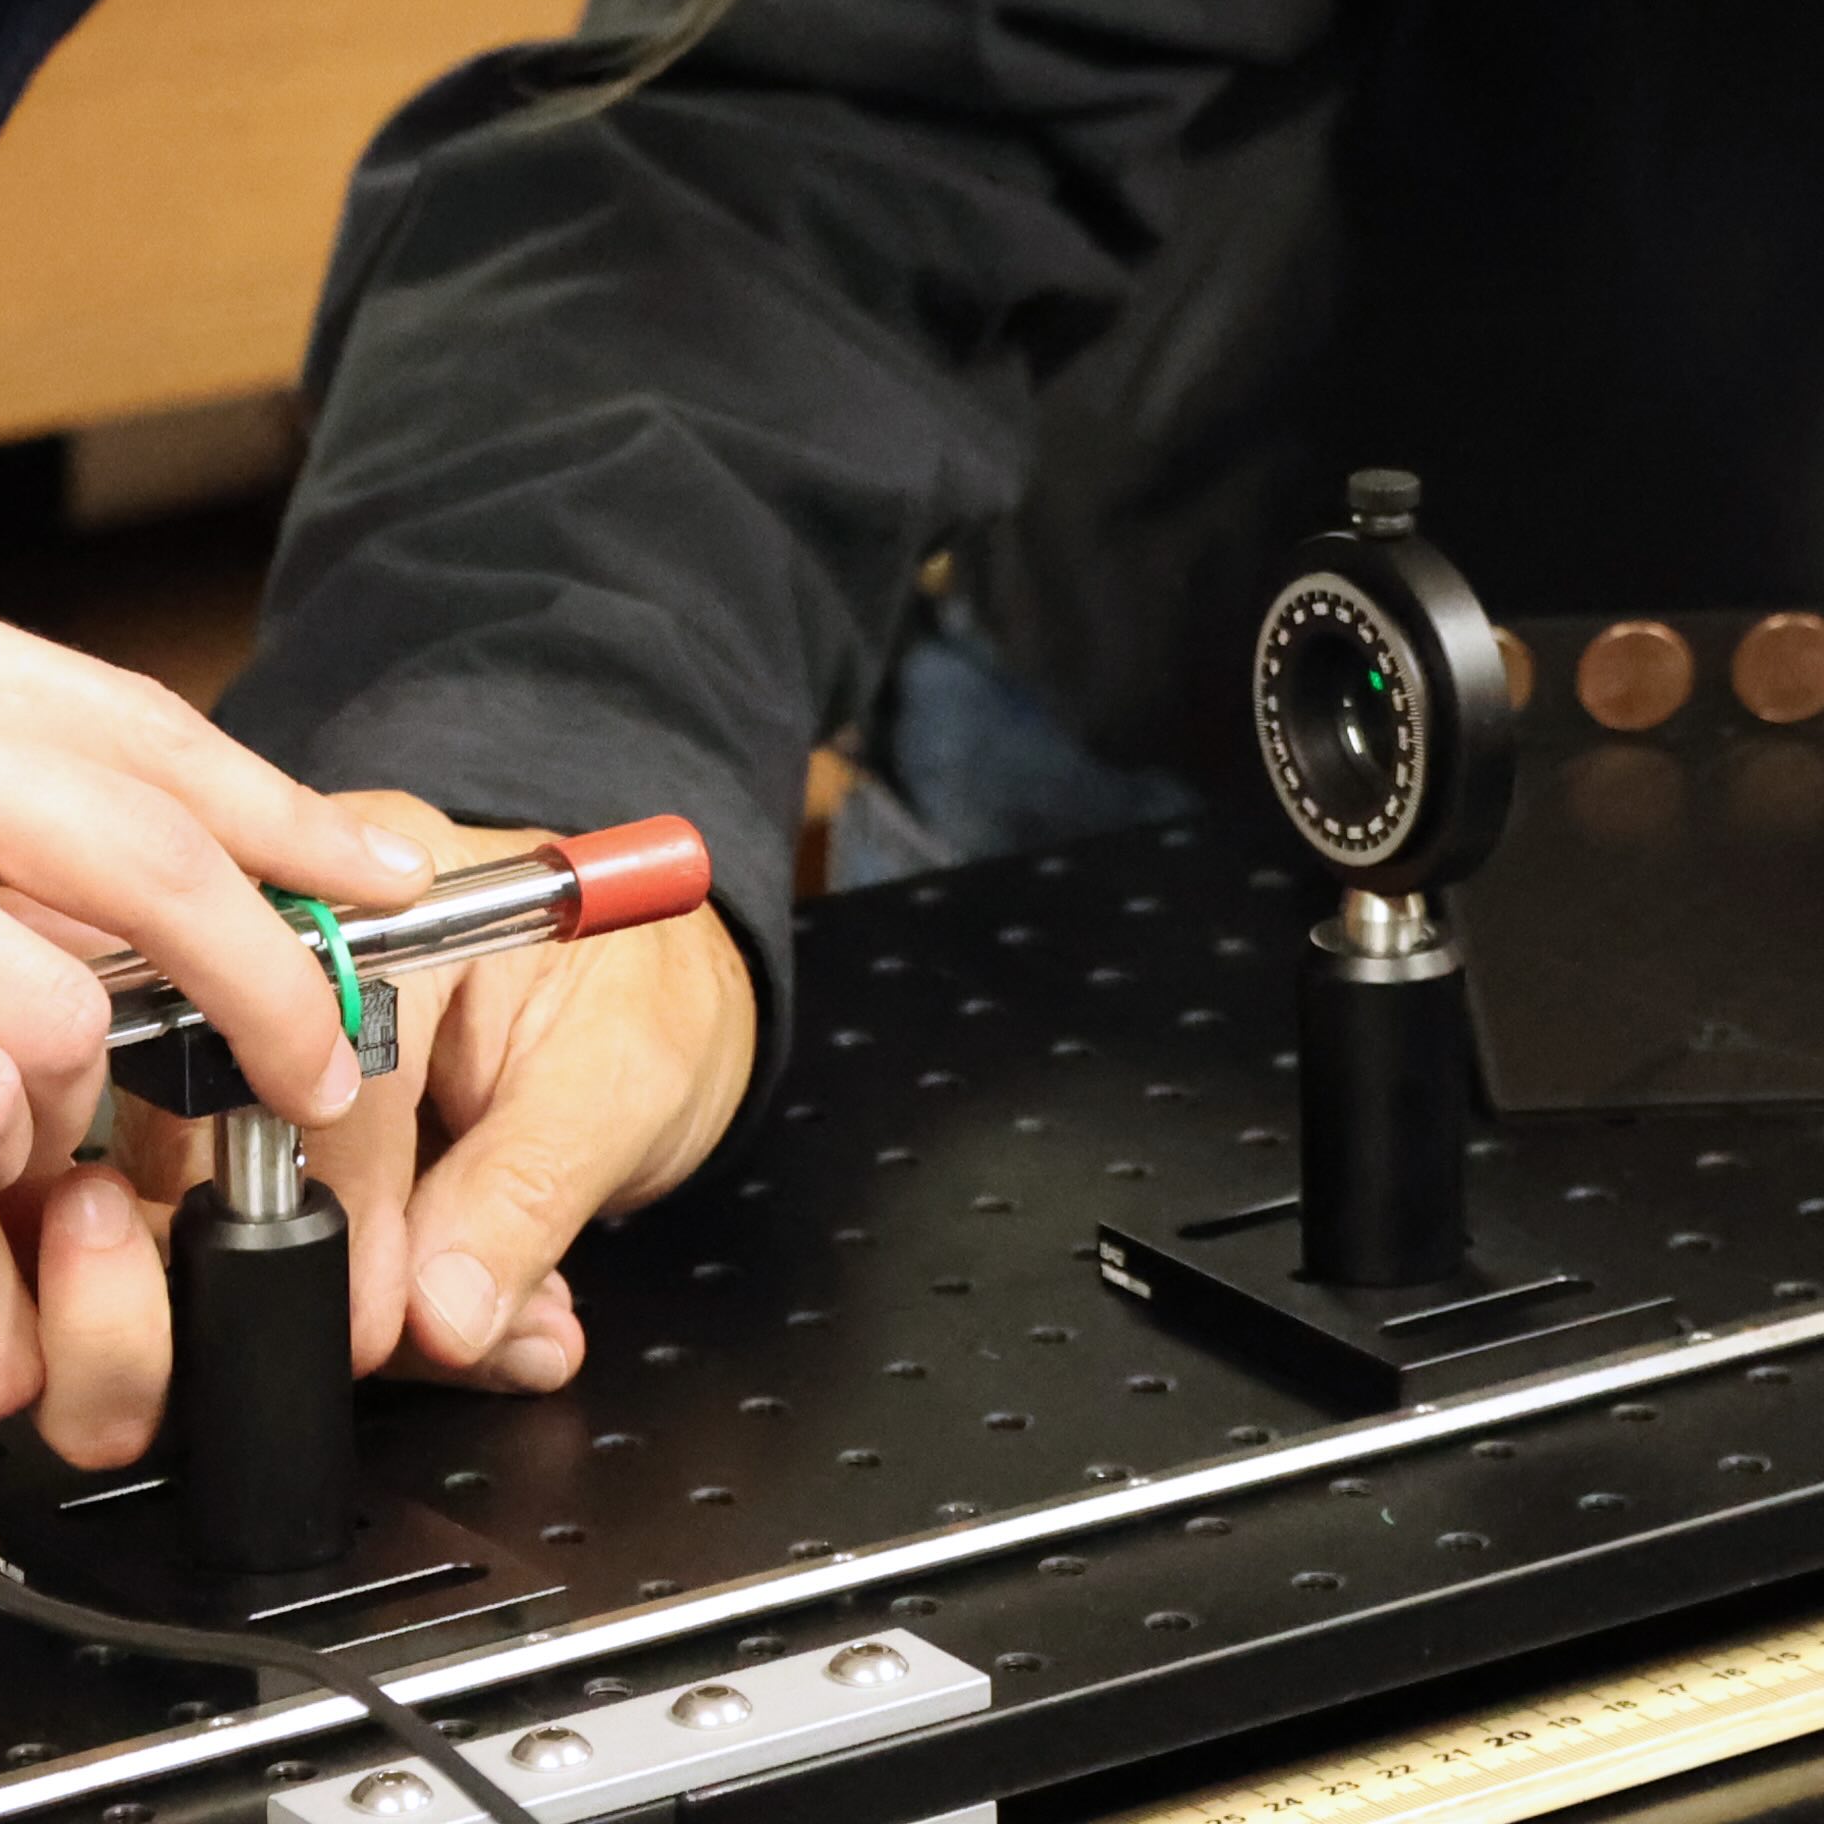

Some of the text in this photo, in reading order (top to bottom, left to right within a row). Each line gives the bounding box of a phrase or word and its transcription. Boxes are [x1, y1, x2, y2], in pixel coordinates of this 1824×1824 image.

[1263, 1797, 1303, 1813] 24
[1319, 1781, 1360, 1796] 23
[1376, 1764, 1419, 1780] 22
[1432, 1748, 1473, 1764] 21
[1483, 1730, 1533, 1748] 20
[1546, 1715, 1583, 1730] 19
[1601, 1699, 1639, 1714] 18
[1657, 1683, 1689, 1697] 17
[1711, 1667, 1748, 1681] 16
[1765, 1651, 1801, 1665] 15
